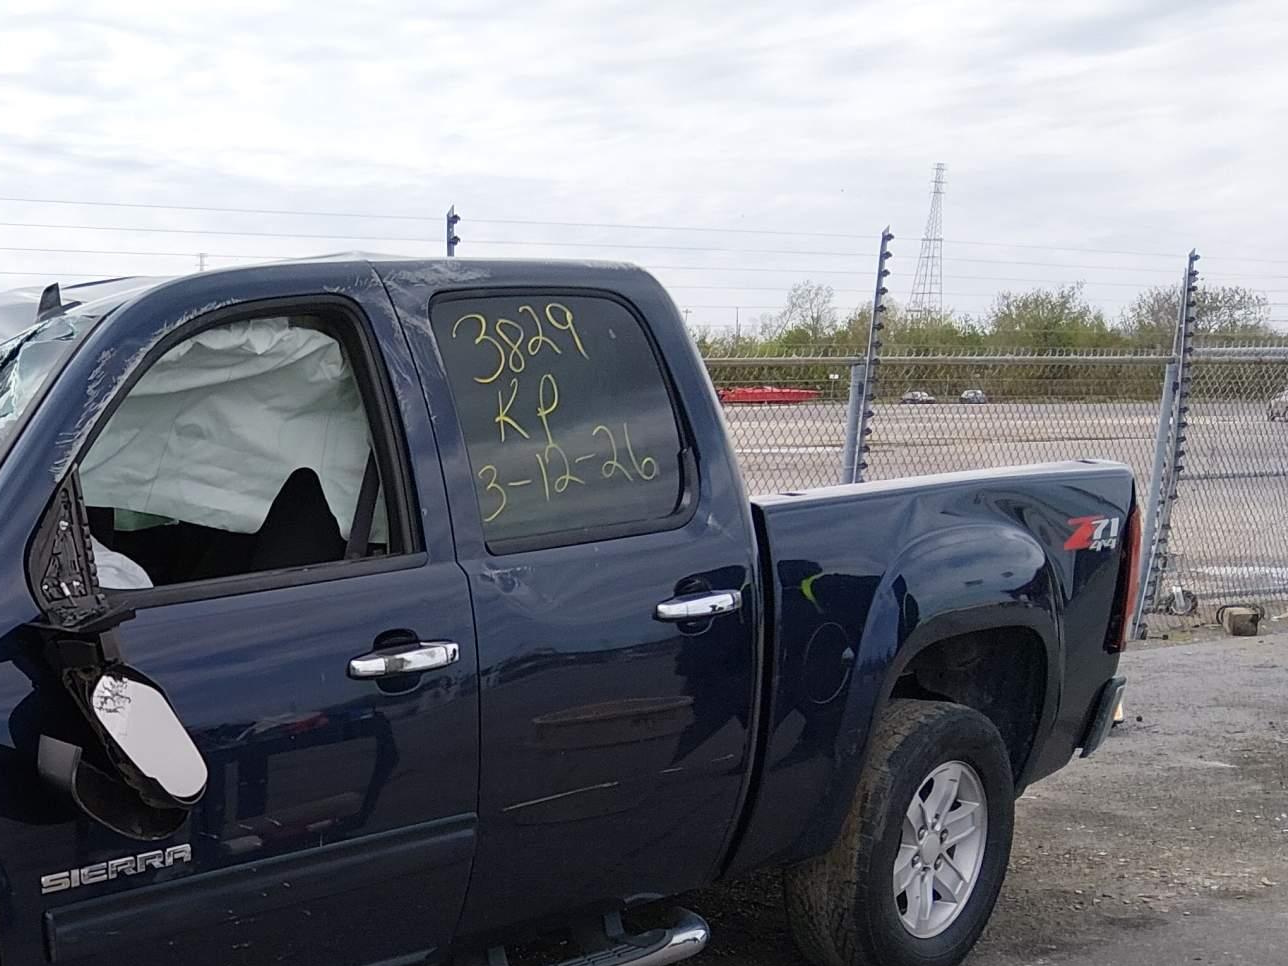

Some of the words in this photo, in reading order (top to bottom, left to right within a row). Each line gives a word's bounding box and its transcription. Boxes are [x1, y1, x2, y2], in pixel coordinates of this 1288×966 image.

[452, 303, 589, 383] 3829
[478, 422, 657, 523] 3-12-26
[1064, 515, 1119, 551] Z71
[41, 843, 192, 894] SIERRA
